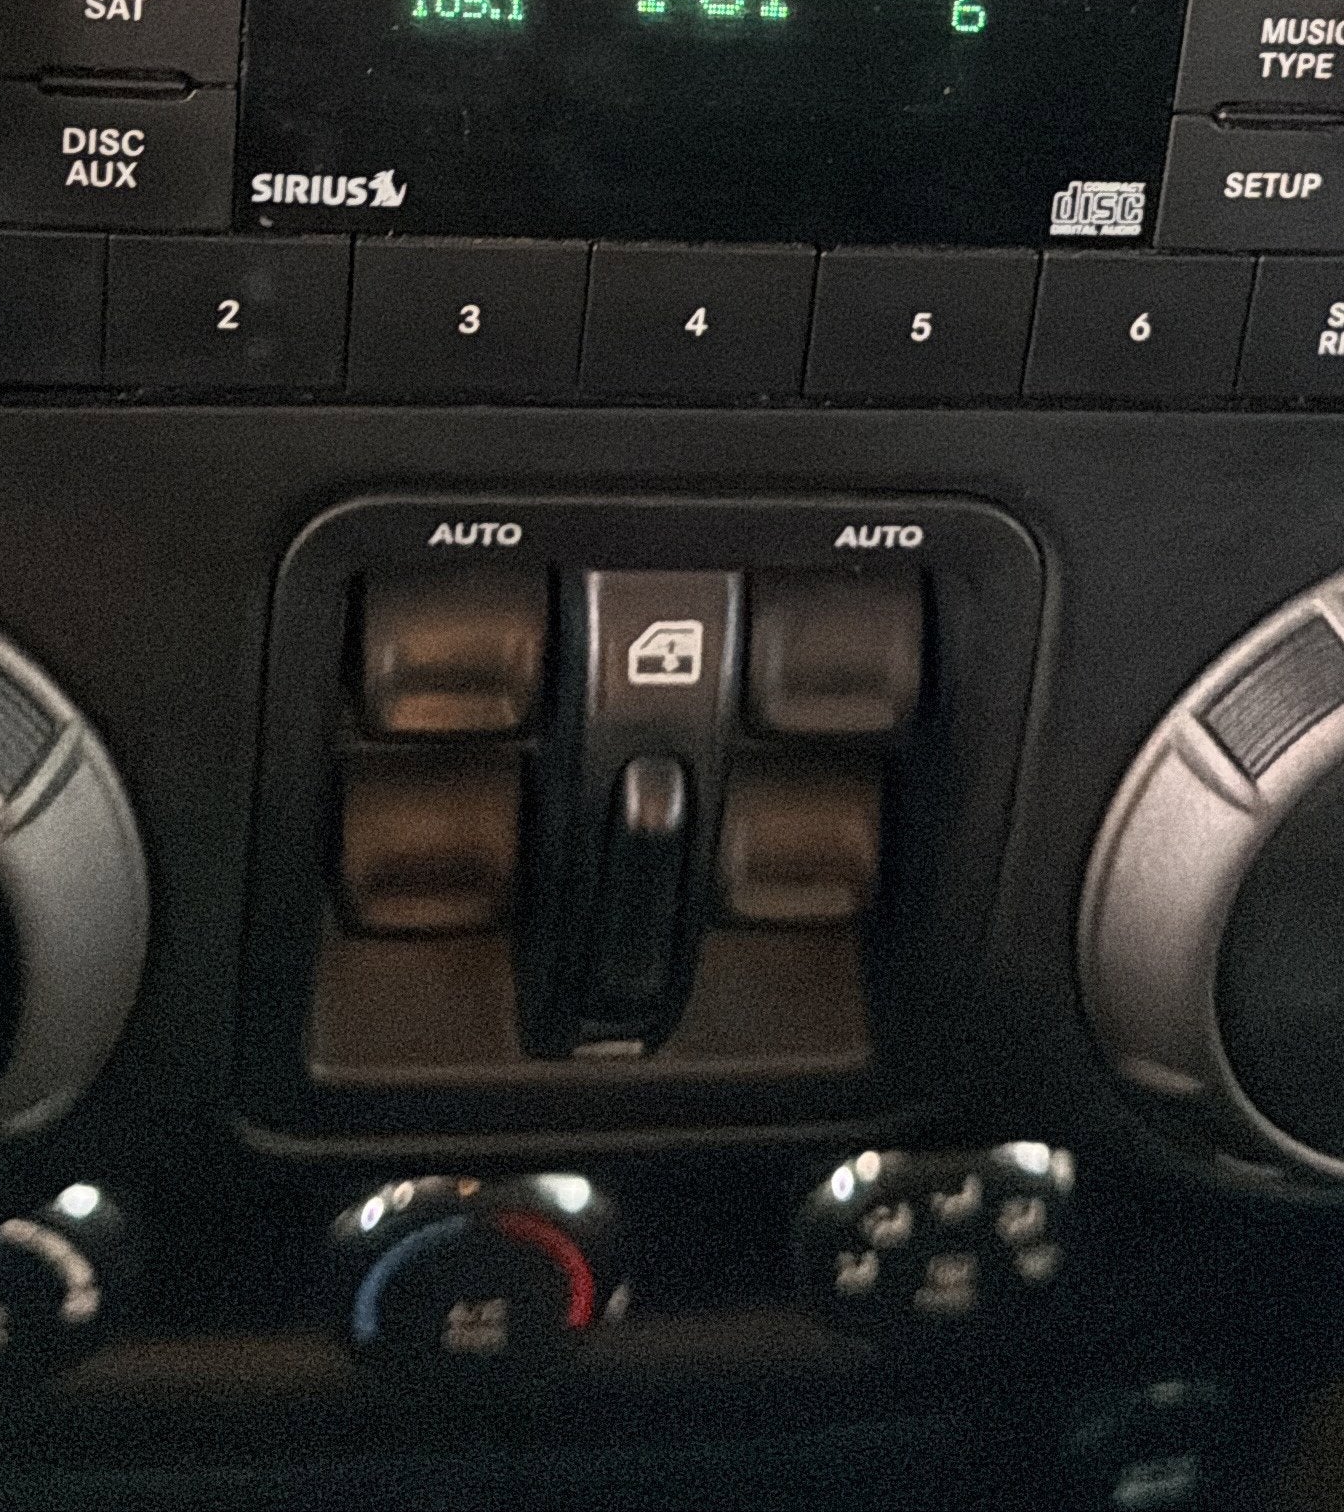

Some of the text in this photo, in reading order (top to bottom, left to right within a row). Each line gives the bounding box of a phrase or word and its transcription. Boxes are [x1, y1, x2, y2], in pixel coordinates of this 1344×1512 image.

[1258, 50, 1335, 81] TYPE
[61, 126, 146, 159] DISC
[64, 162, 138, 189] AUX
[250, 171, 368, 207] SIRIUS
[1222, 170, 1323, 200] SETUP
[216, 299, 241, 330] 2
[457, 304, 482, 336] 3
[683, 306, 709, 338] 4
[909, 311, 933, 343] 5
[1128, 311, 1152, 343] 6
[428, 521, 523, 547] AUTO
[834, 524, 924, 549] AUTO
